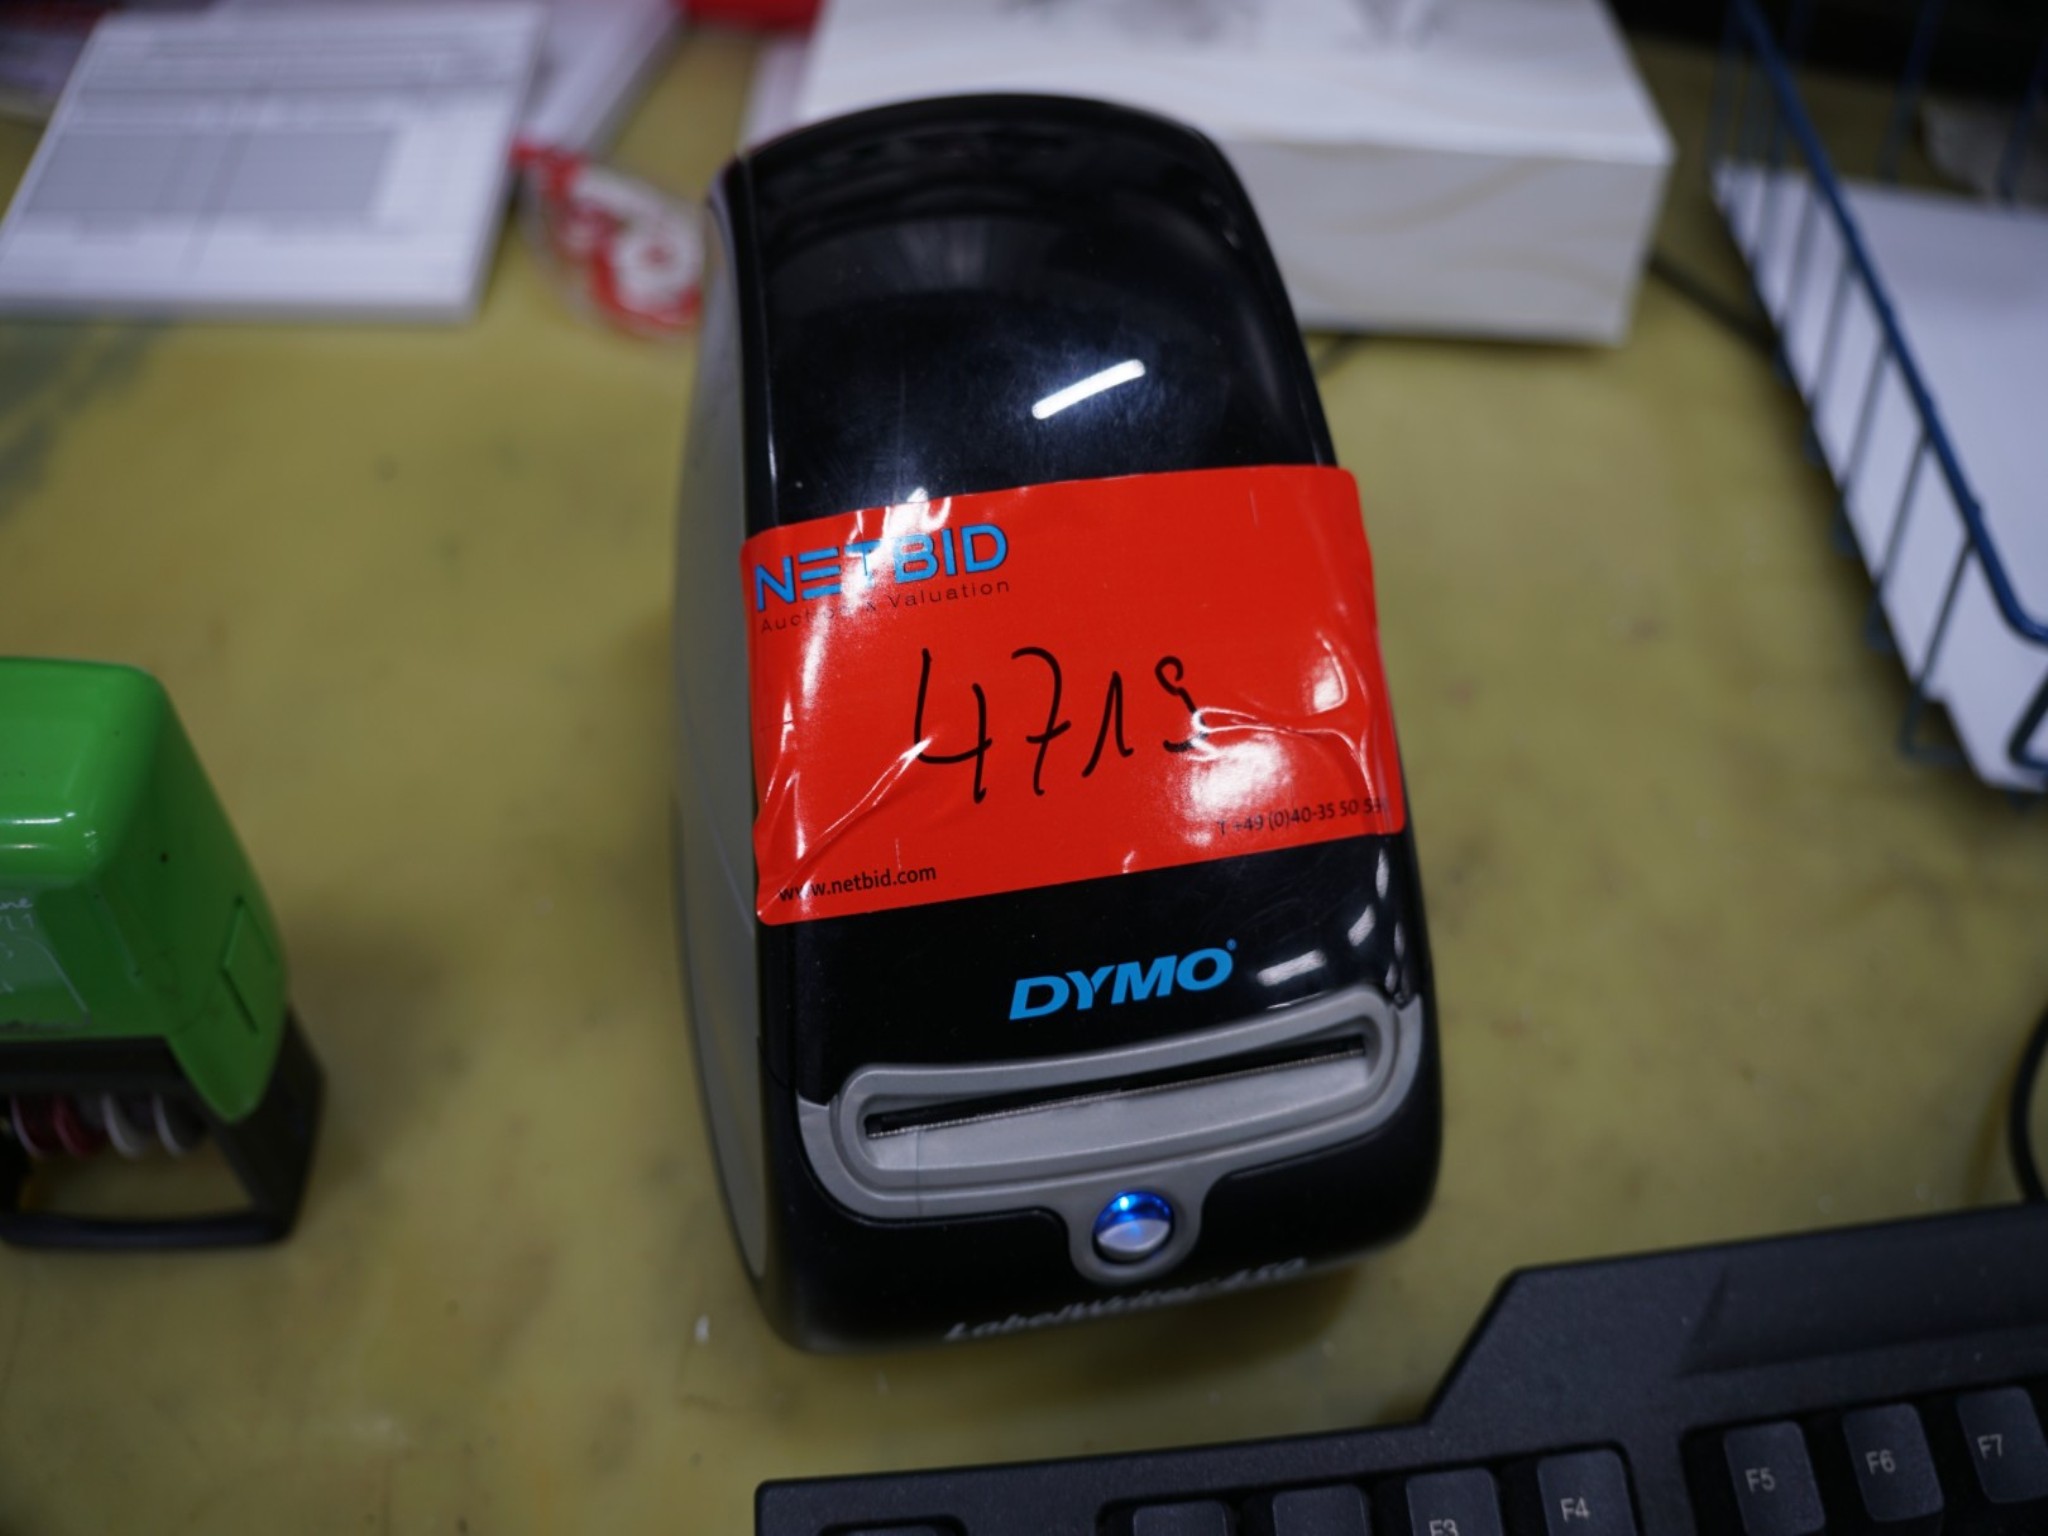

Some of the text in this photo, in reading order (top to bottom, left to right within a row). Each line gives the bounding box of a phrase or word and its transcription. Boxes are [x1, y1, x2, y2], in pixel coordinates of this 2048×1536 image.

[754, 524, 1008, 612] NETBID
[761, 606, 854, 634] Aucton
[889, 580, 1010, 608] Valuation
[913, 647, 1209, 804] 4719
[1233, 813, 1264, 832] +49
[1268, 803, 1335, 831] (0)40-35
[1339, 799, 1359, 817] 50
[1009, 947, 1234, 1021] DYMO
[1865, 1449, 1897, 1475] F6
[1977, 1433, 2003, 1459] F7
[1745, 1467, 1776, 1493] F5
[1560, 1497, 1590, 1522] F4
